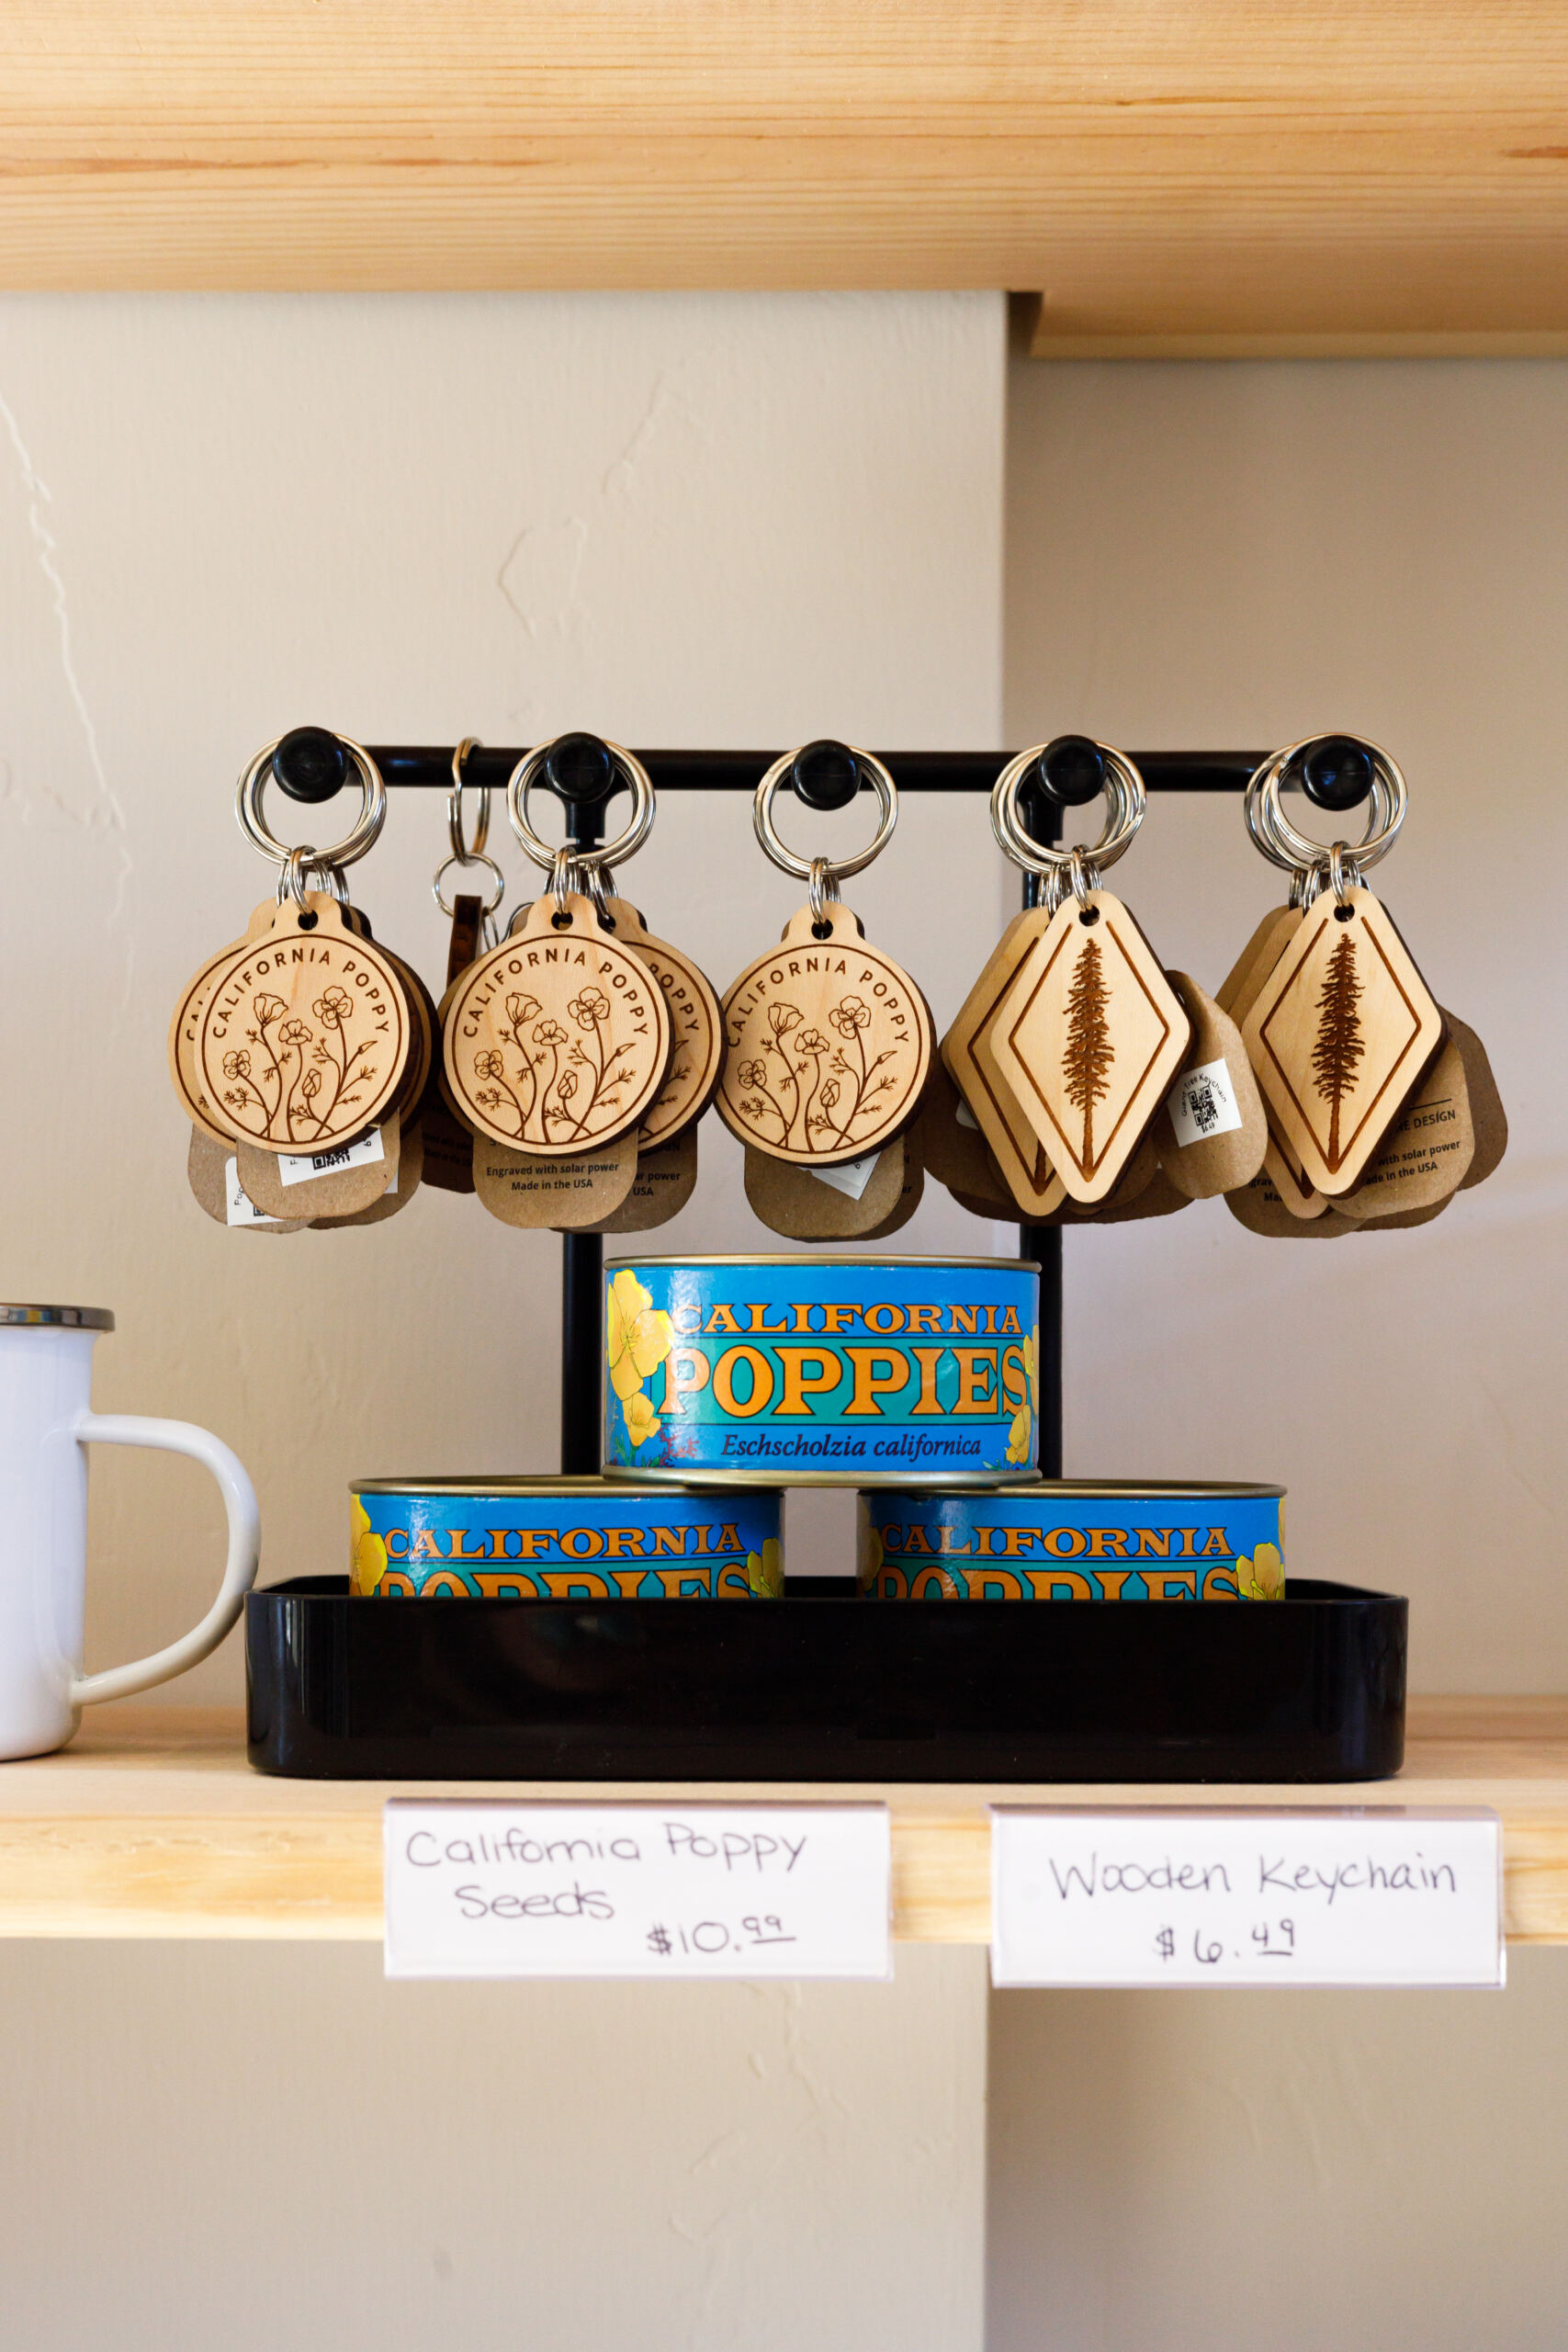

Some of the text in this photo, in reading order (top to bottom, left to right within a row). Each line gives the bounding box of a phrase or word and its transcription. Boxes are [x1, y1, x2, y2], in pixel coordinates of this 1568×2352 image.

[213, 948, 331, 1039] CALIFORNIA
[342, 961, 389, 1033] POPPY
[463, 948, 648, 1037] CALIFORNIA POPPY
[728, 957, 908, 1047] CALIFORNIA POPPY
[1414, 1110, 1456, 1129] DESIGN
[1402, 1148, 1427, 1162] solar
[1429, 1140, 1461, 1156] power
[486, 1162, 619, 1178] Engraved with solar power
[512, 1179, 593, 1192] Made in the USA
[648, 1170, 681, 1182] power
[1386, 1171, 1396, 1182] in
[1398, 1168, 1416, 1179] the
[1417, 1160, 1438, 1173] USA
[671, 1303, 1024, 1334] CALIFORNIA
[656, 1344, 1030, 1419] POPPIES
[721, 1433, 981, 1463] Eschscholzia californica
[383, 1523, 746, 1559] CALIFORNIA
[881, 1524, 1235, 1558] CALIFORNIA
[406, 1823, 807, 1871] California Poppy
[1049, 1850, 1456, 1905] Wooden Keychain
[455, 1882, 615, 1919] Seeds
[648, 1916, 797, 1955] $10.99
